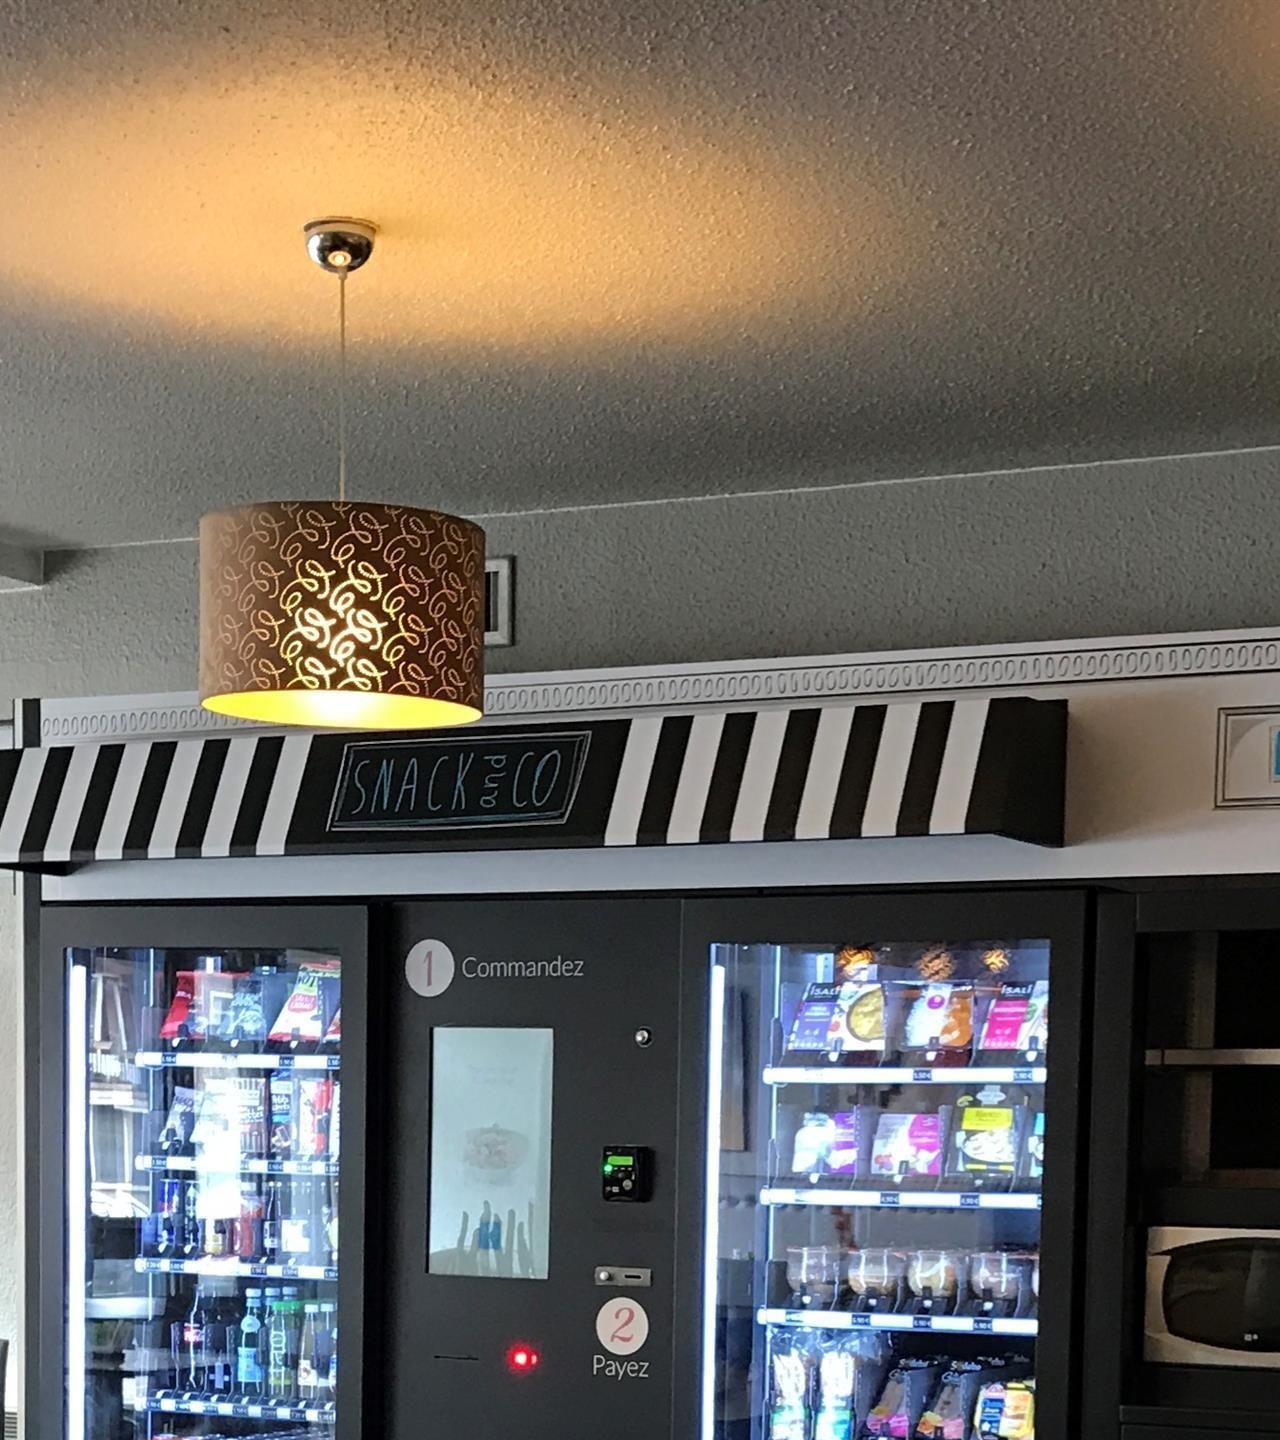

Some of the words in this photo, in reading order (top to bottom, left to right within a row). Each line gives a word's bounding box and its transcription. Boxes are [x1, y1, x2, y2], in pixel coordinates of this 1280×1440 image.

[351, 752, 474, 815] SNACK
[479, 754, 508, 808] and
[512, 749, 562, 808] CO
[461, 955, 585, 978] Commandez
[610, 1306, 635, 1343] 2
[592, 1354, 650, 1381] Payez
